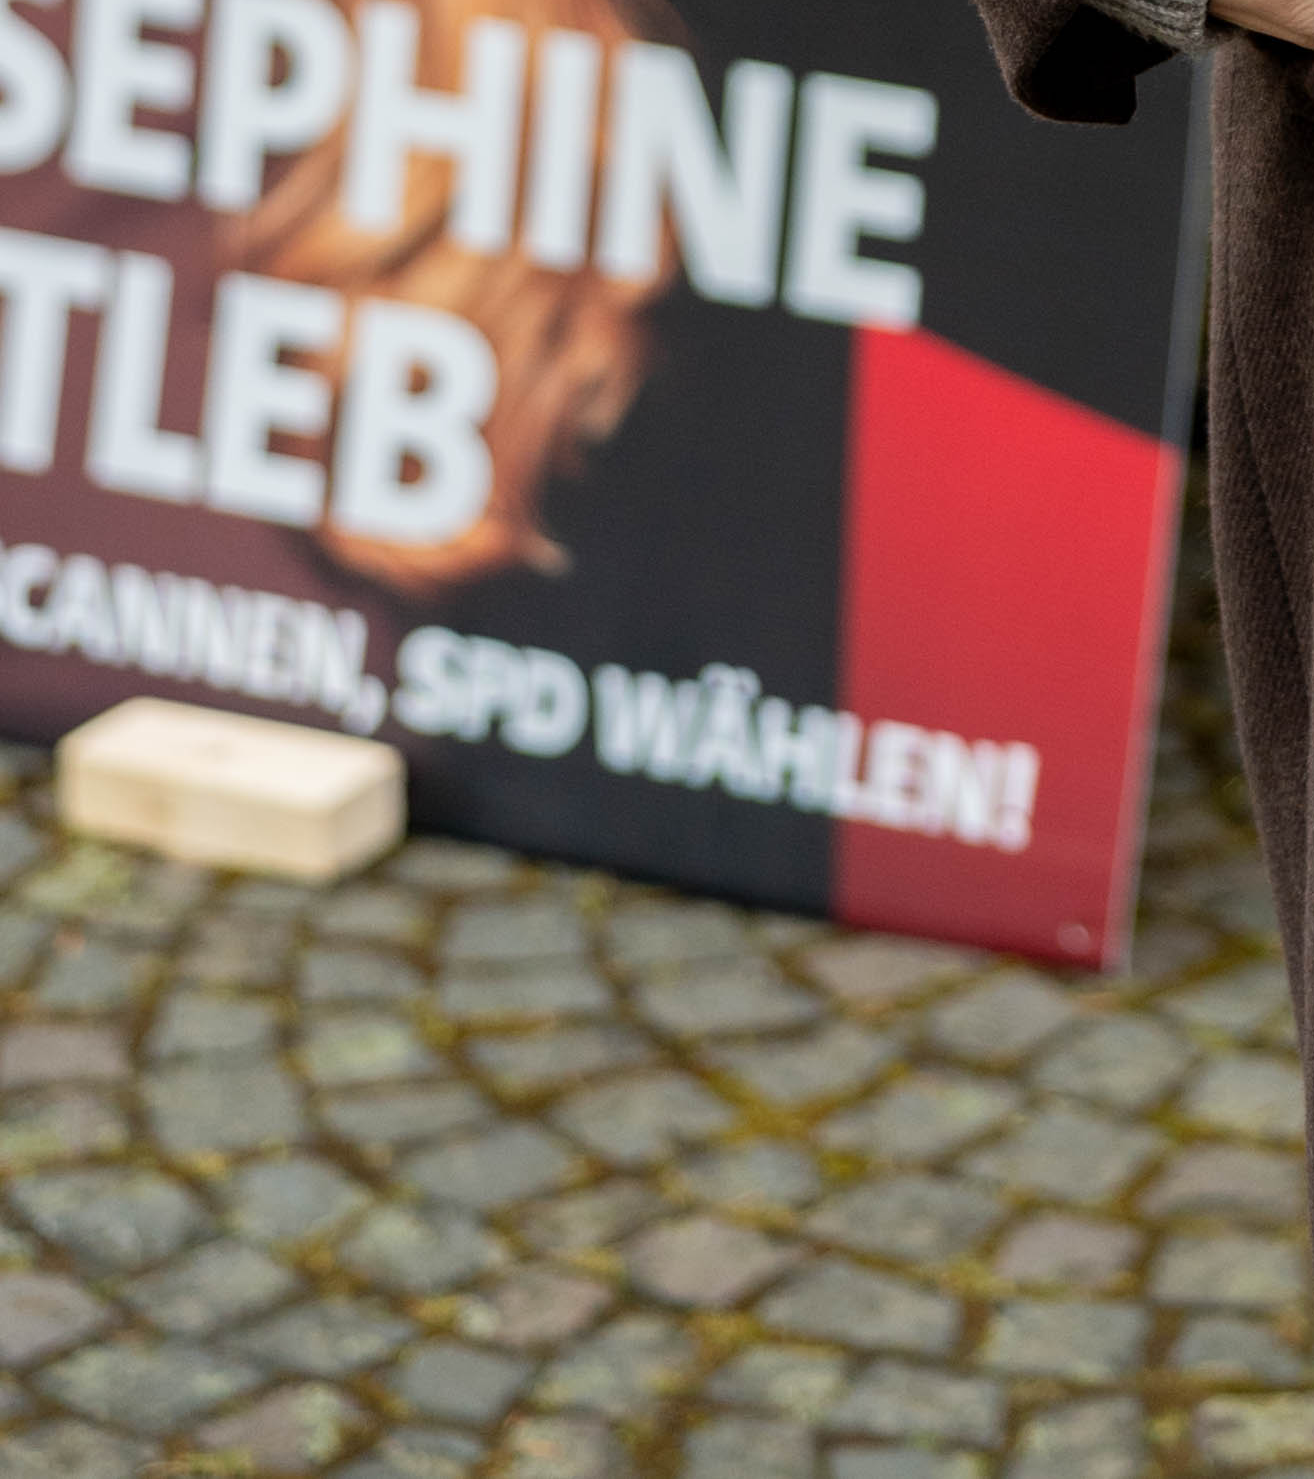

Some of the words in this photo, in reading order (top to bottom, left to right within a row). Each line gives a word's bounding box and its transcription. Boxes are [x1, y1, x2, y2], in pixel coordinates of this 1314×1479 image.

[0, 536, 388, 736] CANNEN,
[393, 624, 590, 760] SPD
[592, 662, 1041, 854] WÄHLEN!
